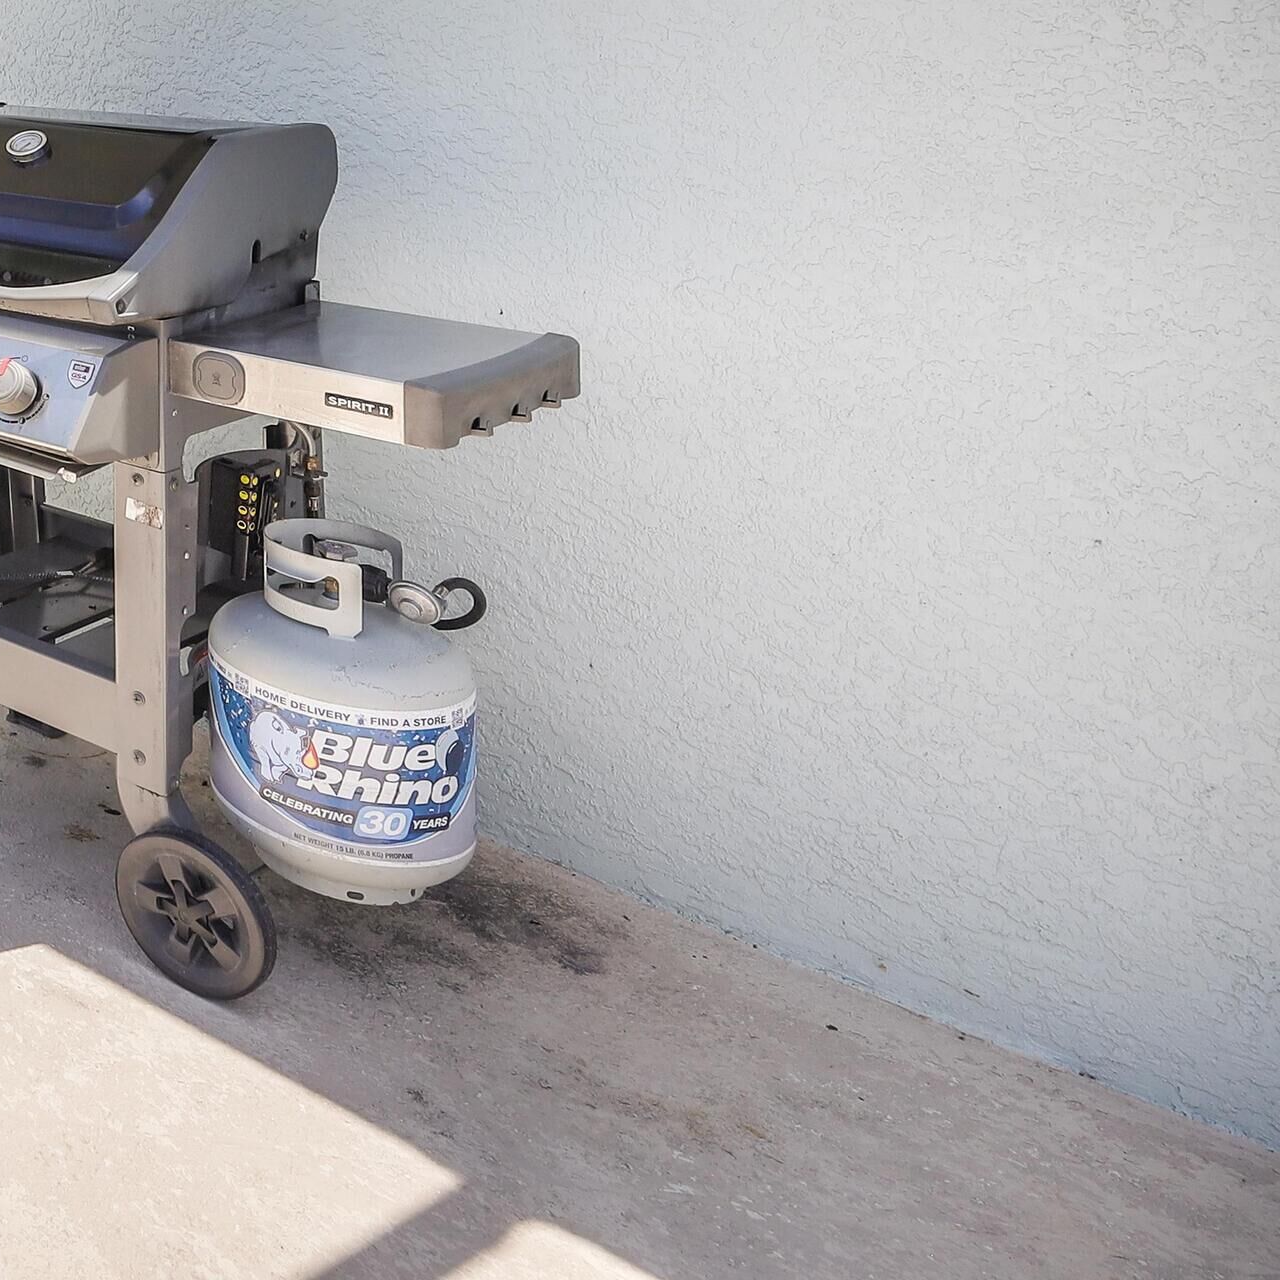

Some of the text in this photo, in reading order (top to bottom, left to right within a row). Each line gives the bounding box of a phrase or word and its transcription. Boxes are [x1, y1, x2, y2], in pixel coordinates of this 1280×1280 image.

[327, 396, 390, 417] SPIRIT II
[255, 687, 446, 727] HOME DELIVERY FIND A STORE
[311, 729, 436, 771] Blue
[297, 764, 458, 805] Rhino
[262, 787, 449, 836] CELEBRATING 30 YEARS
[293, 832, 306, 842] NET
[308, 836, 335, 850] WEIGHT
[335, 844, 344, 852] 15
[385, 852, 414, 861] PROPANE
